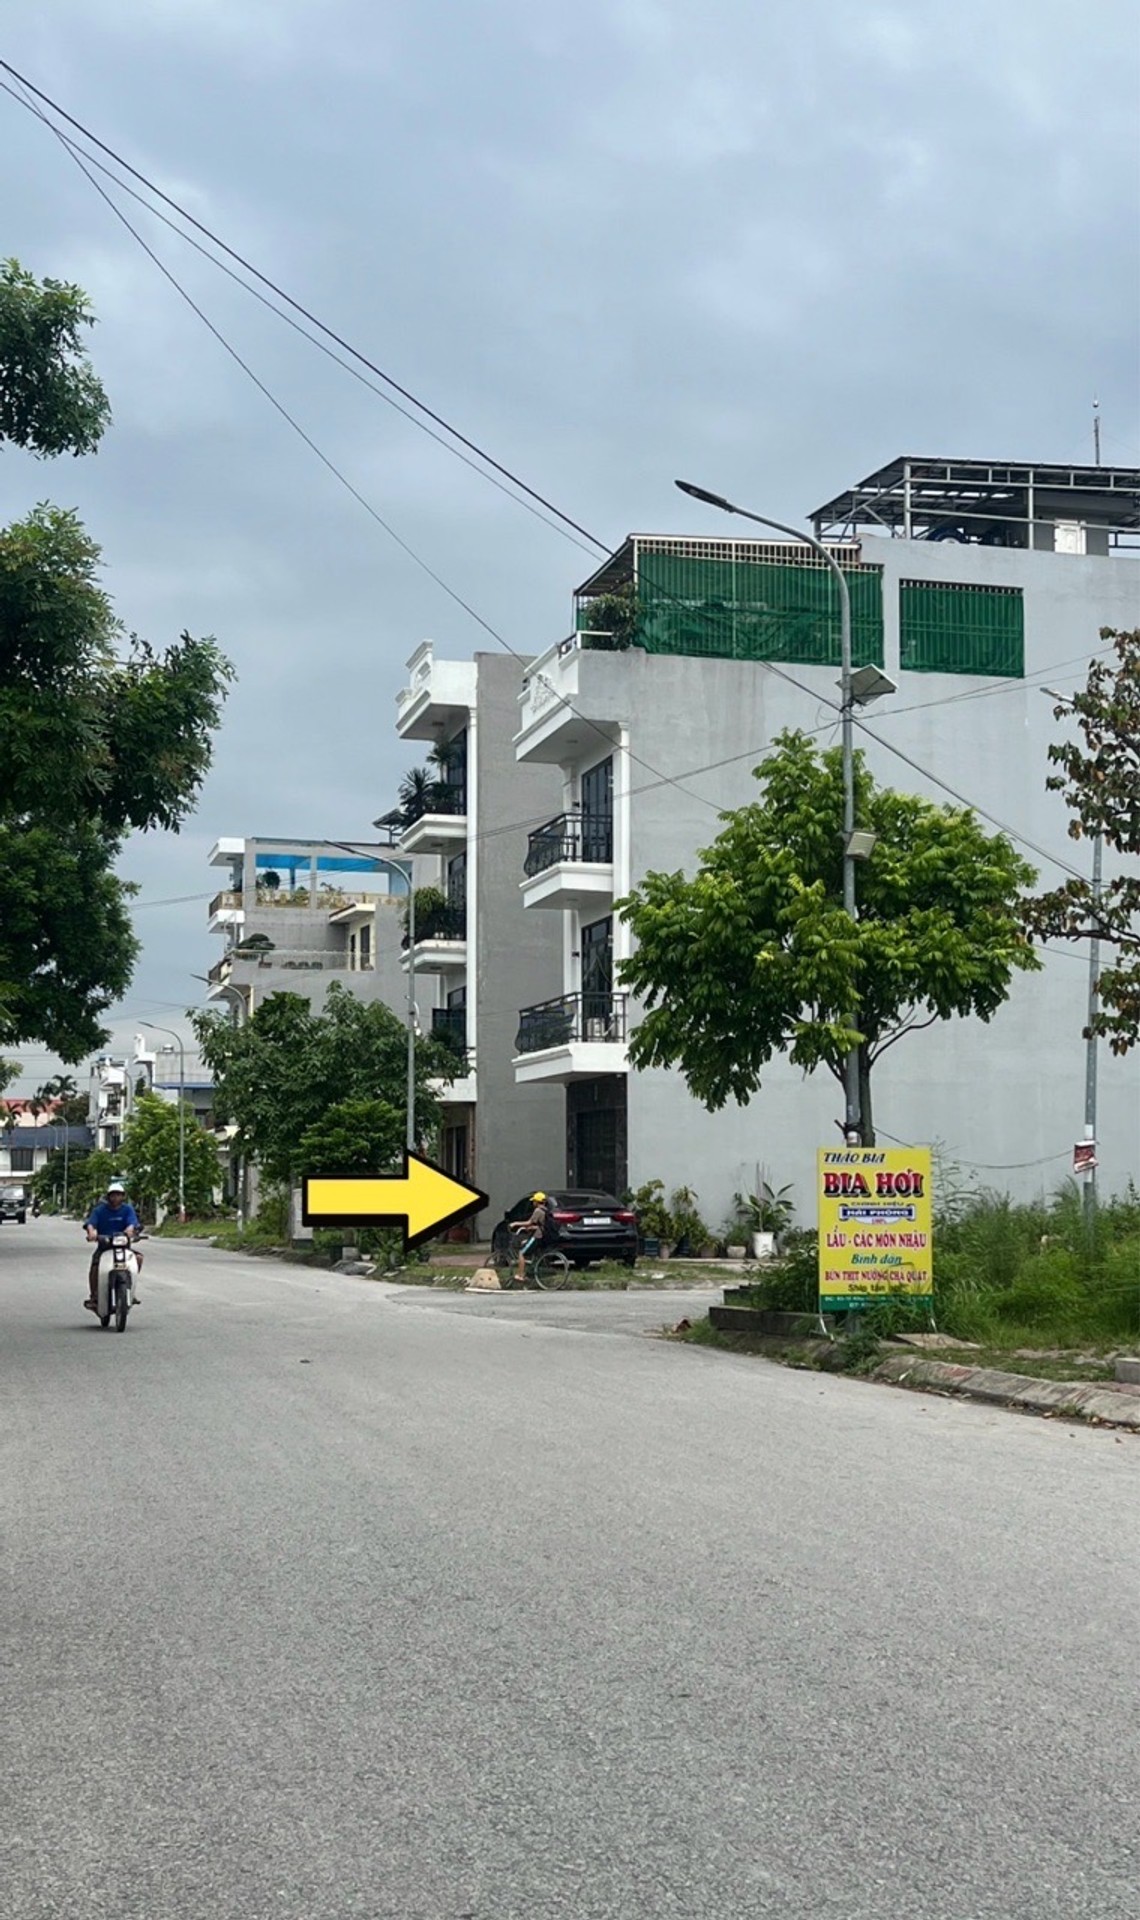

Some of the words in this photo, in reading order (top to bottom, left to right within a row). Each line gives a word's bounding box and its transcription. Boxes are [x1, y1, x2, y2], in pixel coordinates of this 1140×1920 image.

[862, 1153, 885, 1163] BIA
[823, 1172, 872, 1198] BIA
[854, 1230, 873, 1247] CÁC
